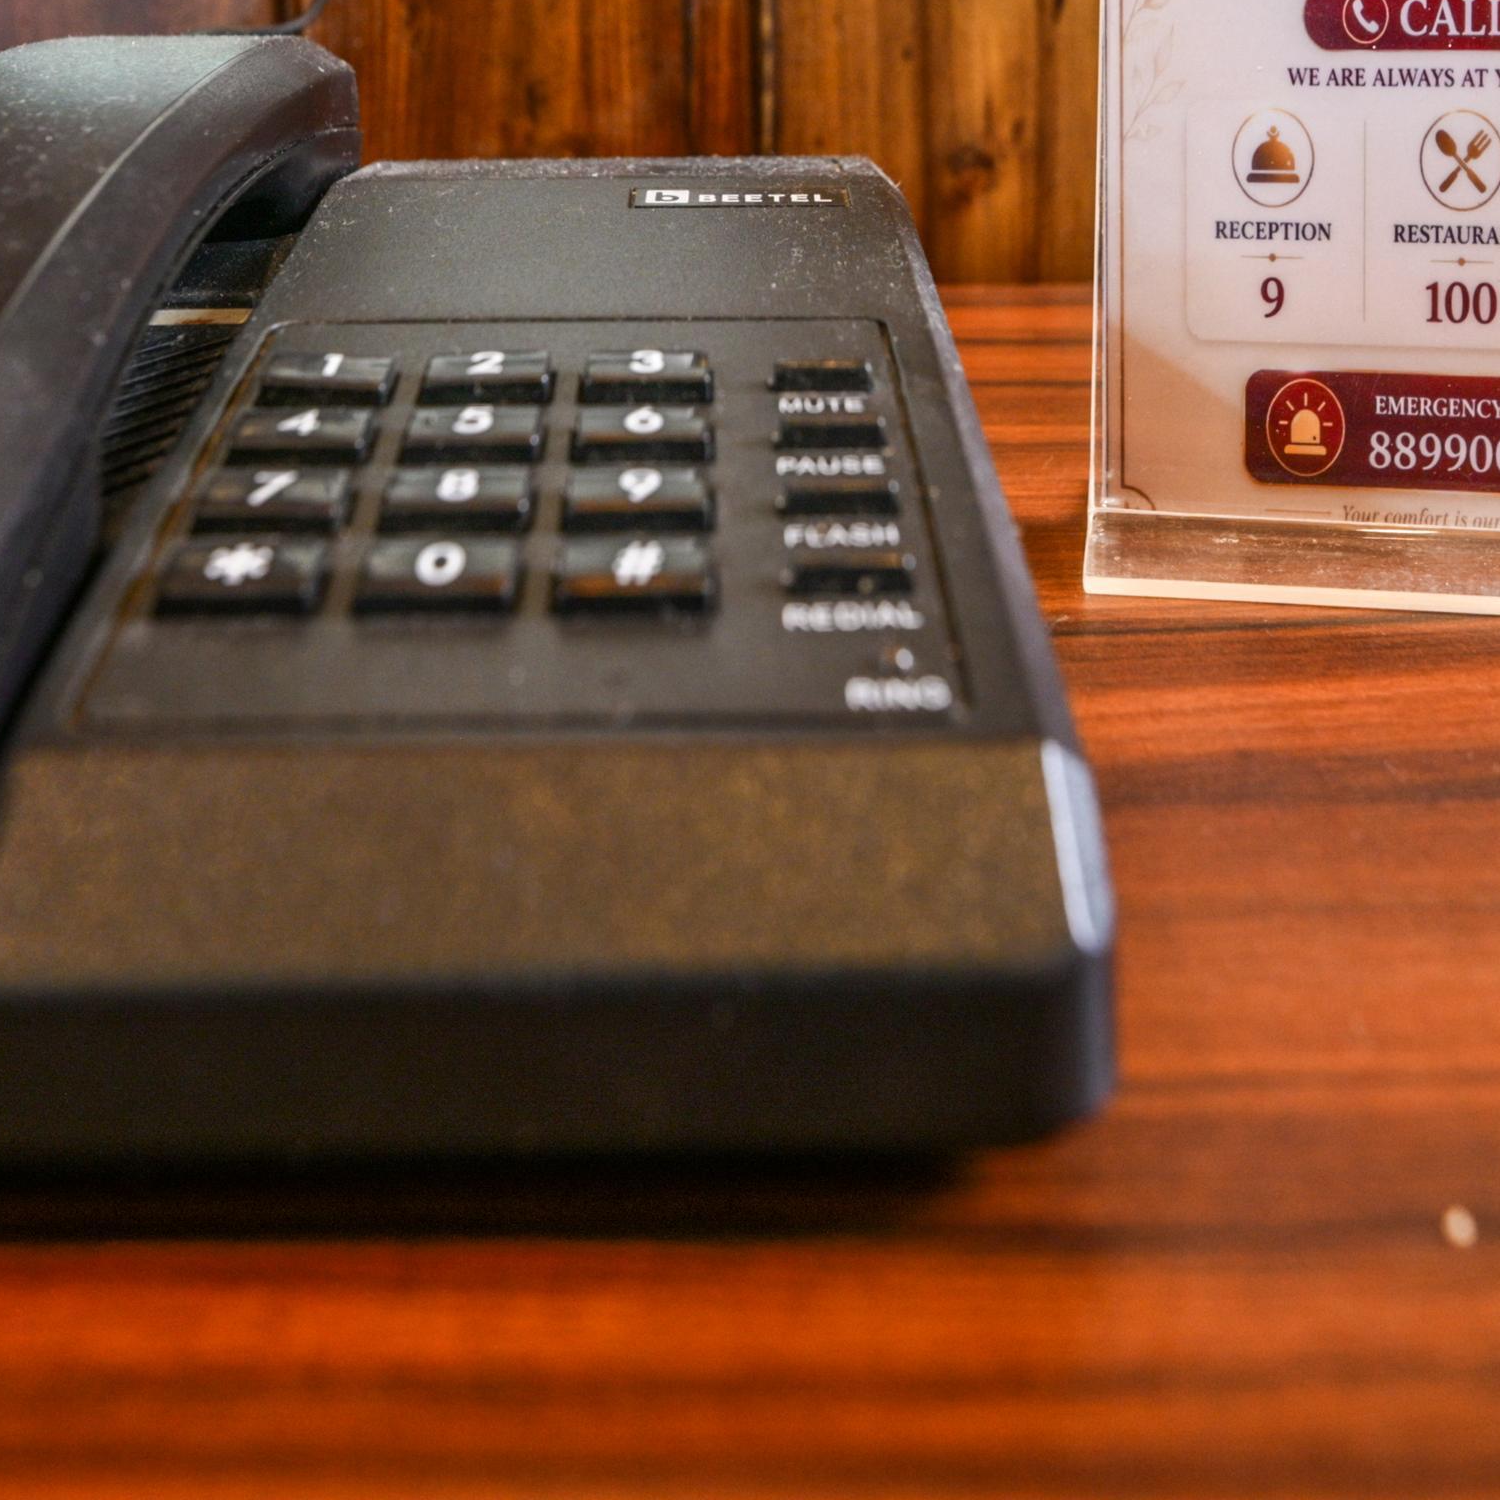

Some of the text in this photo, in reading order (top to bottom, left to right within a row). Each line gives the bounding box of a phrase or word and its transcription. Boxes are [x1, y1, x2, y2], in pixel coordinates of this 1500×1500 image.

[1287, 68, 1321, 87] WE
[1326, 68, 1366, 87] ARE
[1372, 68, 1455, 88] ALWAYS
[1461, 69, 1488, 88] AT
[698, 194, 833, 203] BEETEL
[1215, 221, 1332, 242] RECEPTION
[1260, 277, 1285, 318] 9
[1425, 282, 1498, 324] 100
[322, 353, 344, 377] 1
[467, 350, 504, 375] 2
[629, 350, 665, 373] 3
[778, 396, 864, 413] MUTE
[277, 409, 319, 436] 4
[452, 406, 495, 434] 5
[624, 406, 664, 433] 6
[776, 455, 884, 476] PAUSE
[246, 470, 297, 506] 7
[436, 468, 480, 501] 8
[619, 468, 663, 502] 9
[1343, 505, 1380, 523] Your
[1384, 508, 1449, 526] comfort
[1454, 510, 1467, 527] is
[783, 523, 900, 548] FLASH
[415, 541, 466, 586] 0
[781, 601, 925, 632] REDIAL
